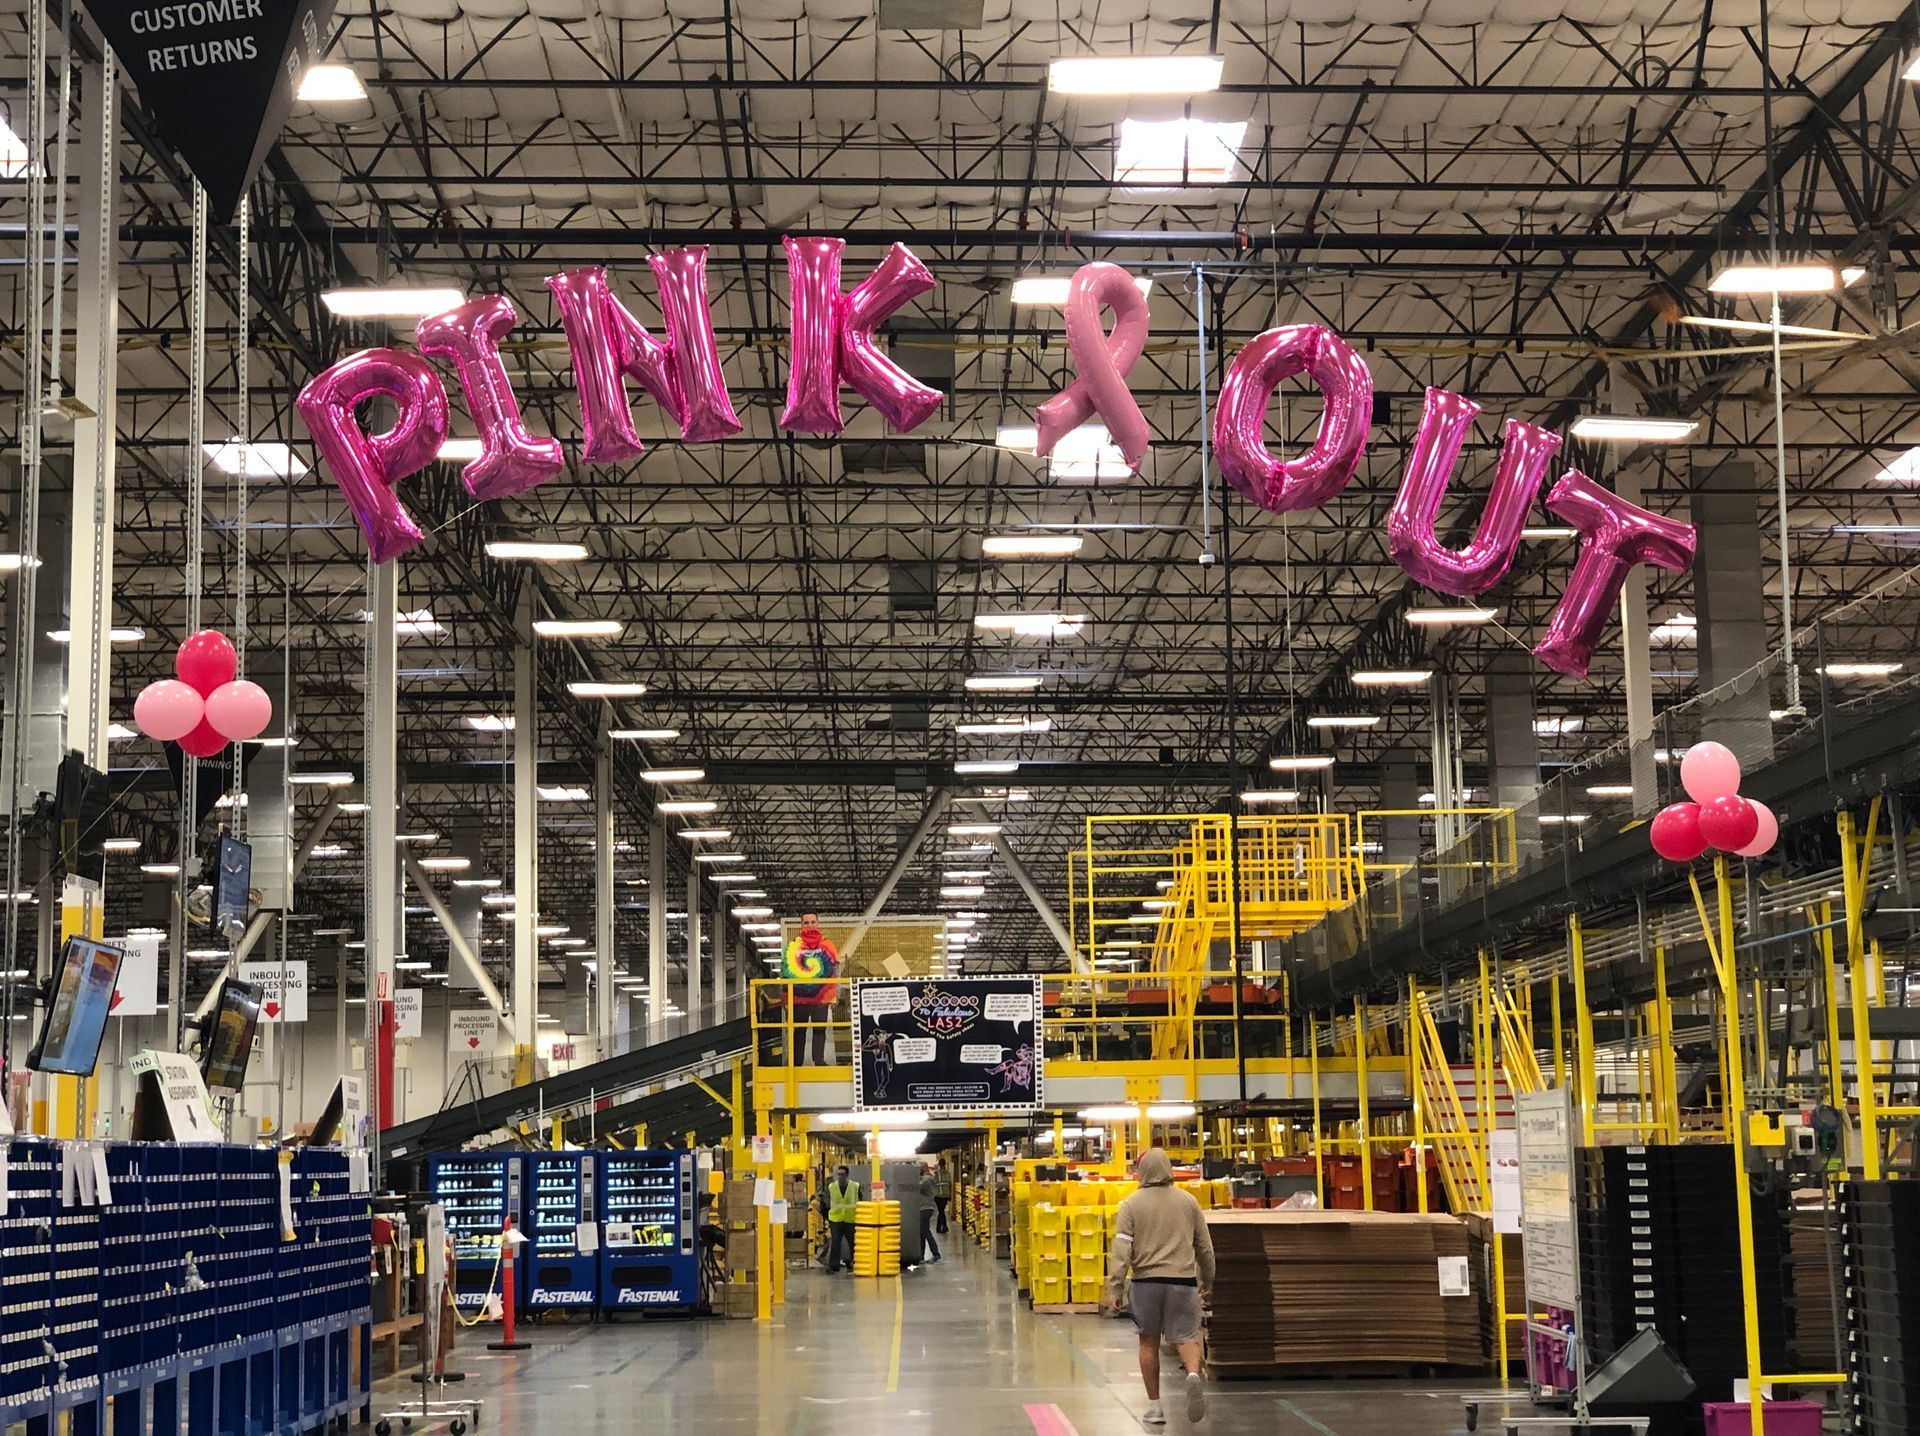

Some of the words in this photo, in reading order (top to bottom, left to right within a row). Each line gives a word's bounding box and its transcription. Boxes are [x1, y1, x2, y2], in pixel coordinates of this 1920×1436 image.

[131, 0, 263, 34] CUSTOMER
[148, 36, 258, 72] RETURNS
[296, 235, 945, 565] PINK
[1212, 323, 1698, 680] OUT
[197, 759, 233, 770] ARNING
[249, 970, 296, 981] INBOUD
[911, 996, 979, 1007] WELCOME
[458, 1015, 491, 1023] INBOUND
[552, 1043, 575, 1061] EXIT
[132, 1057, 152, 1070] IND
[531, 1288, 593, 1304] FASTENAL
[617, 1287, 681, 1304] FASTENAL
